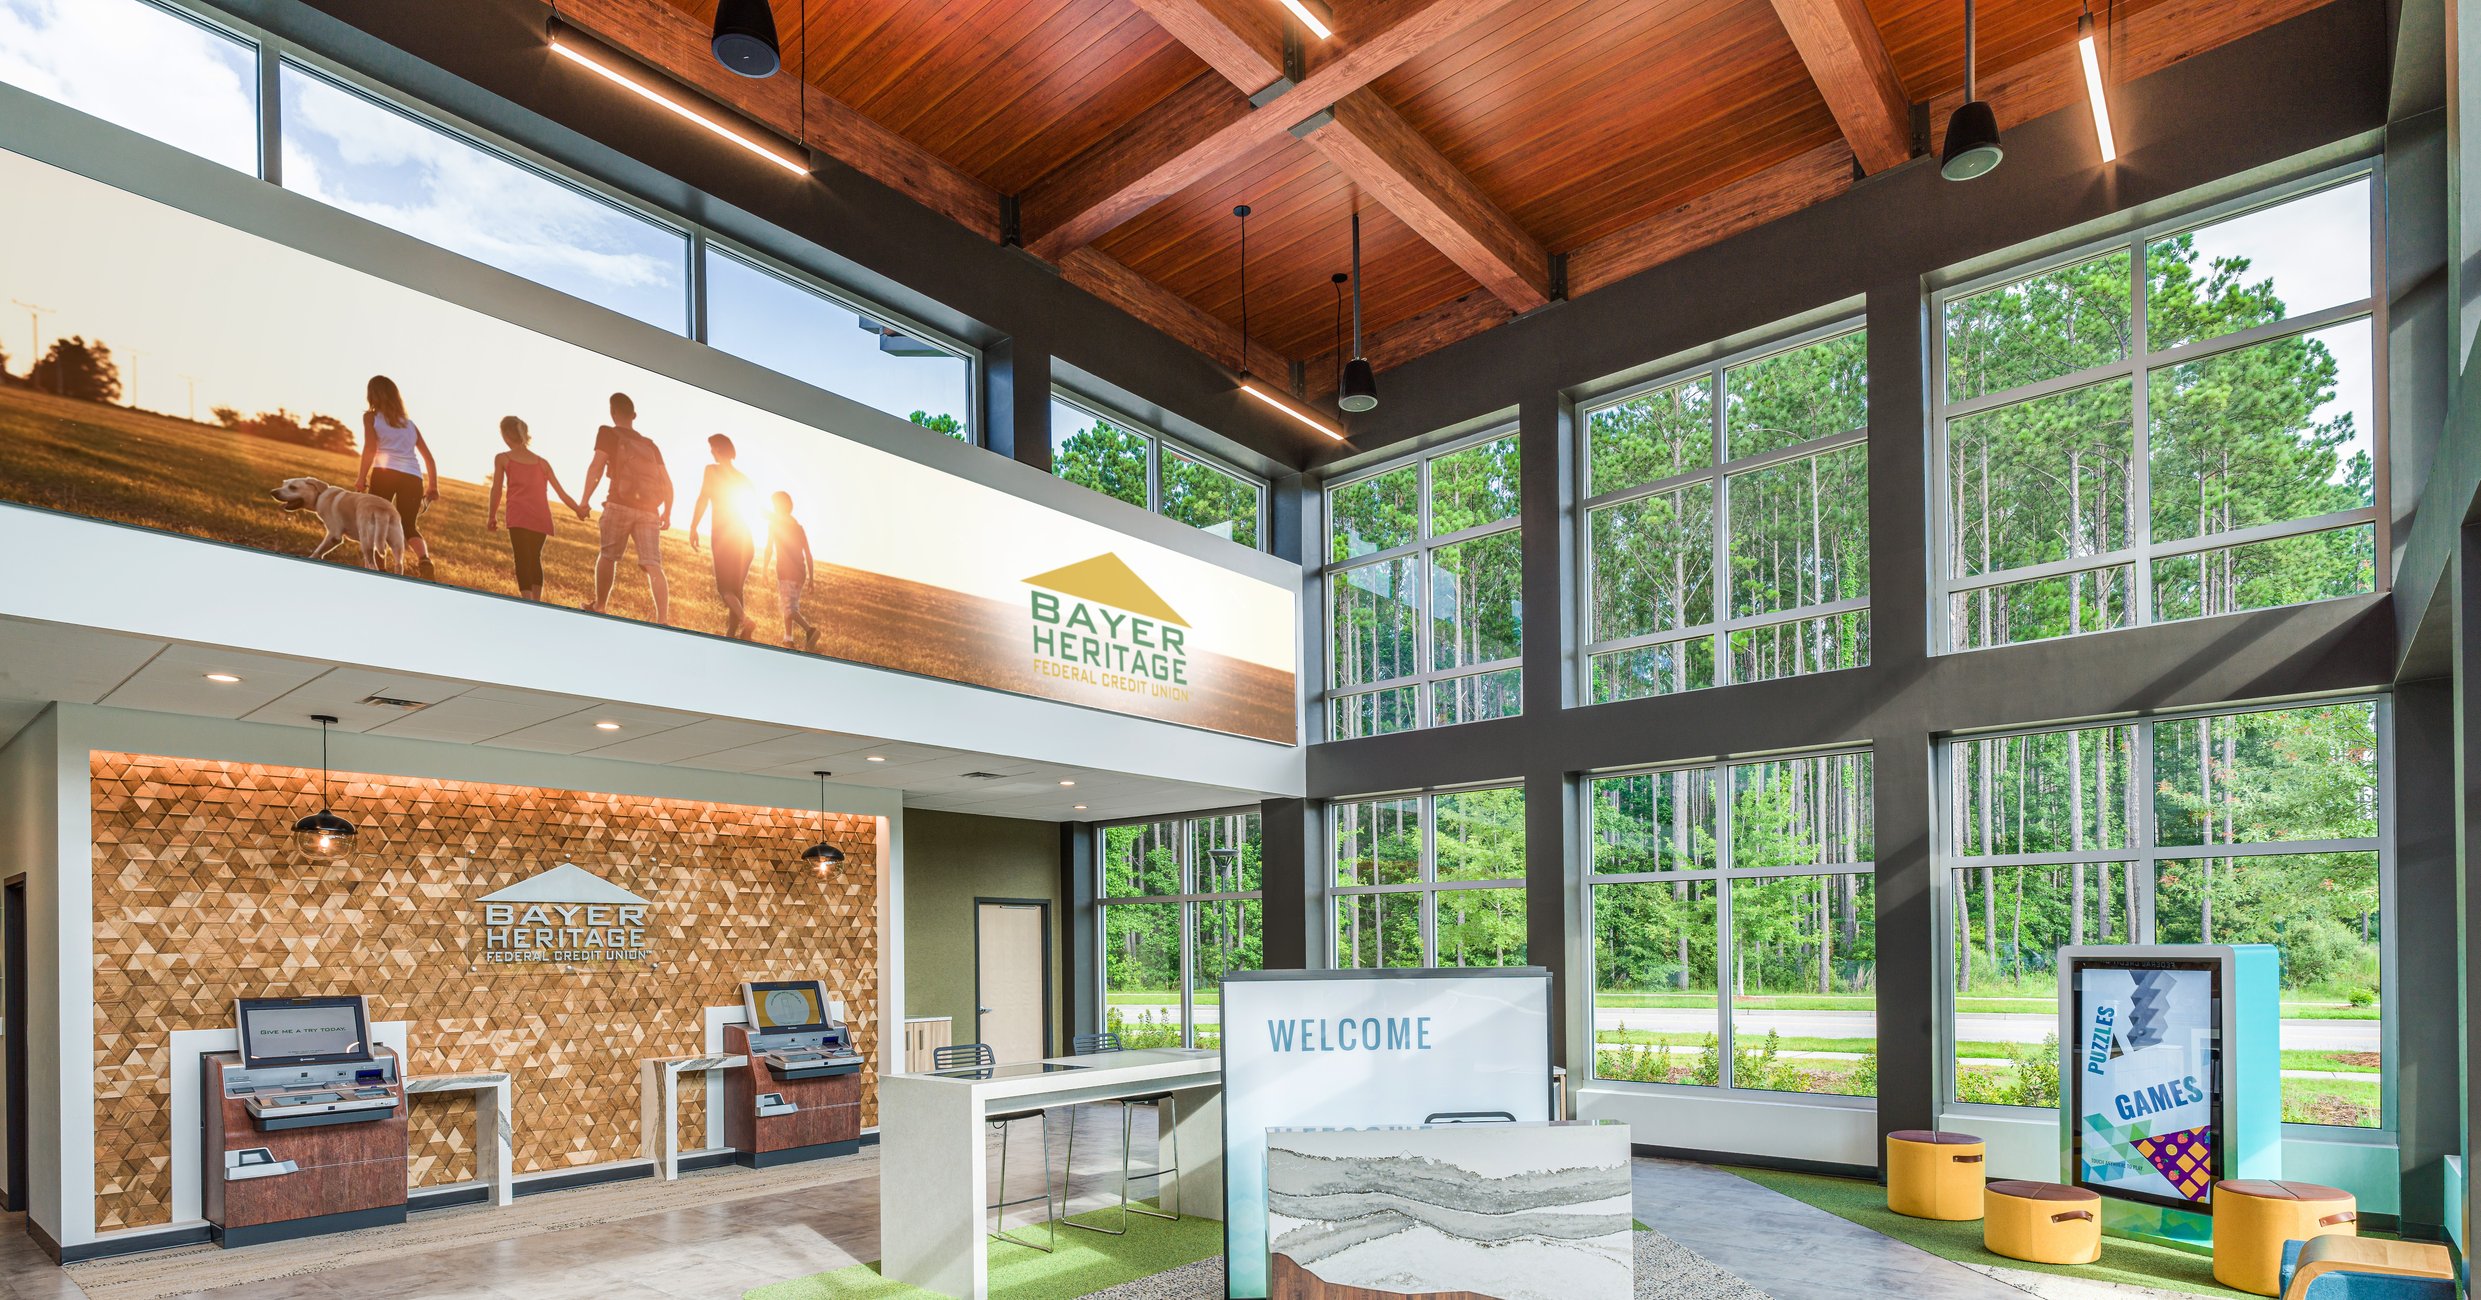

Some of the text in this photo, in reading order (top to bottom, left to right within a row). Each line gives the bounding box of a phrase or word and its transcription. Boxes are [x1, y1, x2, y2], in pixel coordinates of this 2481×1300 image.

[1031, 590, 1186, 656] BAYER
[1033, 625, 1187, 685] HERITAGE
[1033, 658, 1190, 703] FEDERAL CREDIT UNION
[486, 904, 645, 926] BAYER
[486, 928, 645, 949] HERITAGE
[487, 951, 549, 962] FEDERAL
[554, 950, 601, 962] CREDIT
[1267, 1017, 1431, 1052] WELCOME
[2087, 1005, 2115, 1075] PUZZLES
[2114, 1075, 2203, 1120] GAMES
